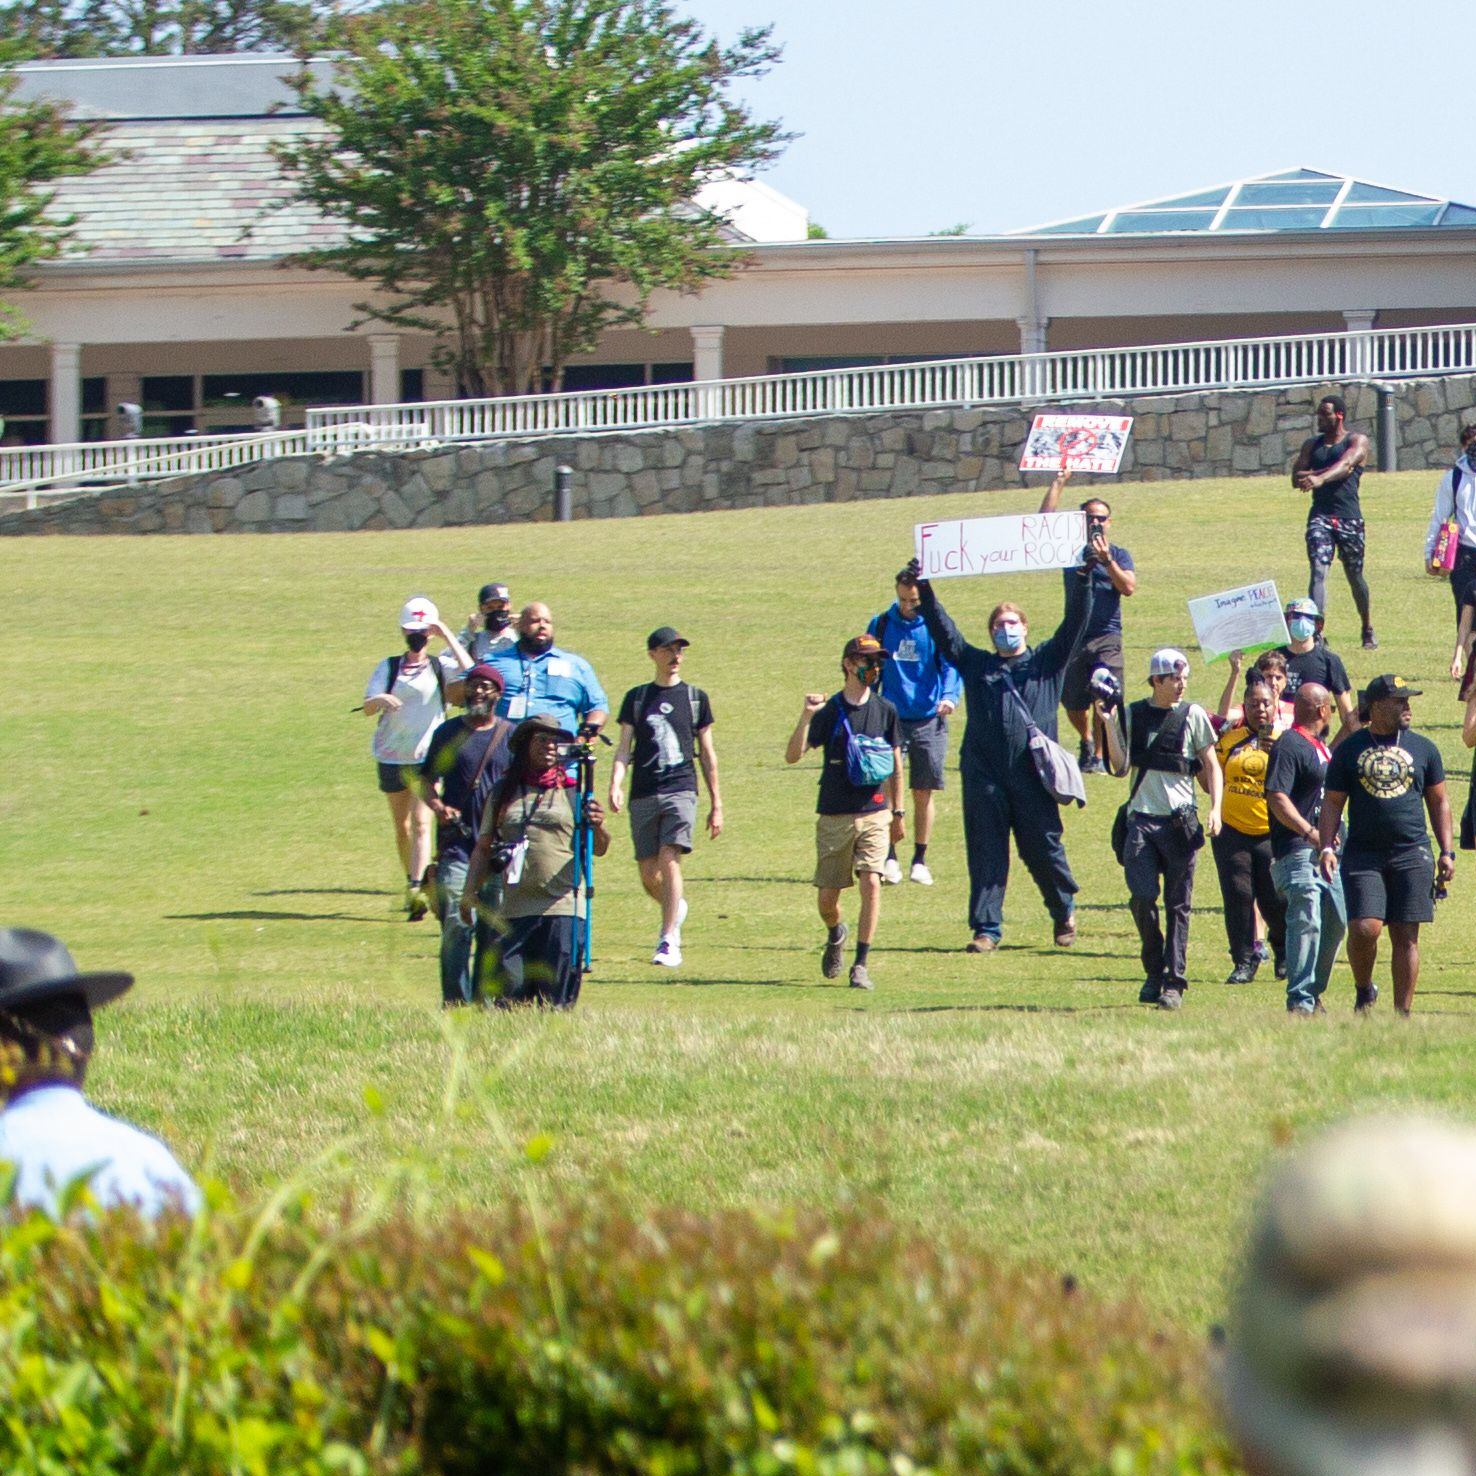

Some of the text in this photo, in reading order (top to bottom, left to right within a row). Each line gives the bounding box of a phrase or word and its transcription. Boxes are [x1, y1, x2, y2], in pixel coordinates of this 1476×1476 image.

[1041, 415, 1124, 429] REMOVE
[1022, 457, 1118, 471] THE HATE
[1021, 512, 1087, 542] RACIST
[920, 522, 1086, 576] Fuck your ROCK
